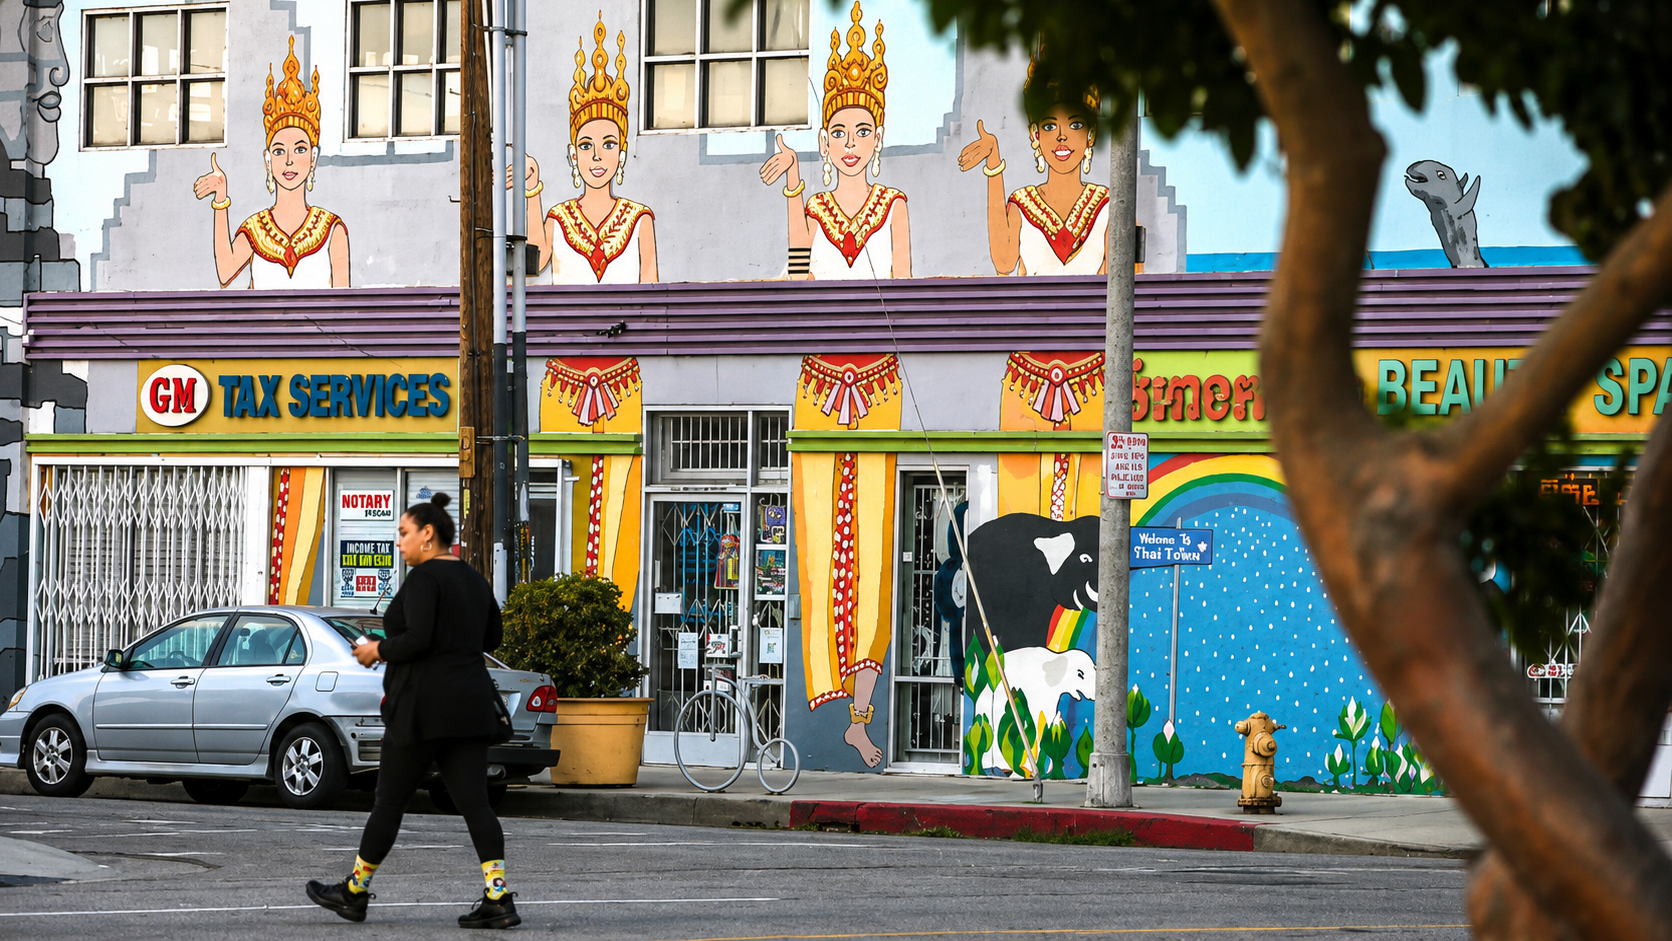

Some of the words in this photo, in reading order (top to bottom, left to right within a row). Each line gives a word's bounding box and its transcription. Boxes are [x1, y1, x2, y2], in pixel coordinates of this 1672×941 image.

[149, 377, 197, 413] GM
[218, 375, 281, 417] TAX
[288, 373, 450, 417] SERVICES
[342, 494, 391, 508] NOTARY
